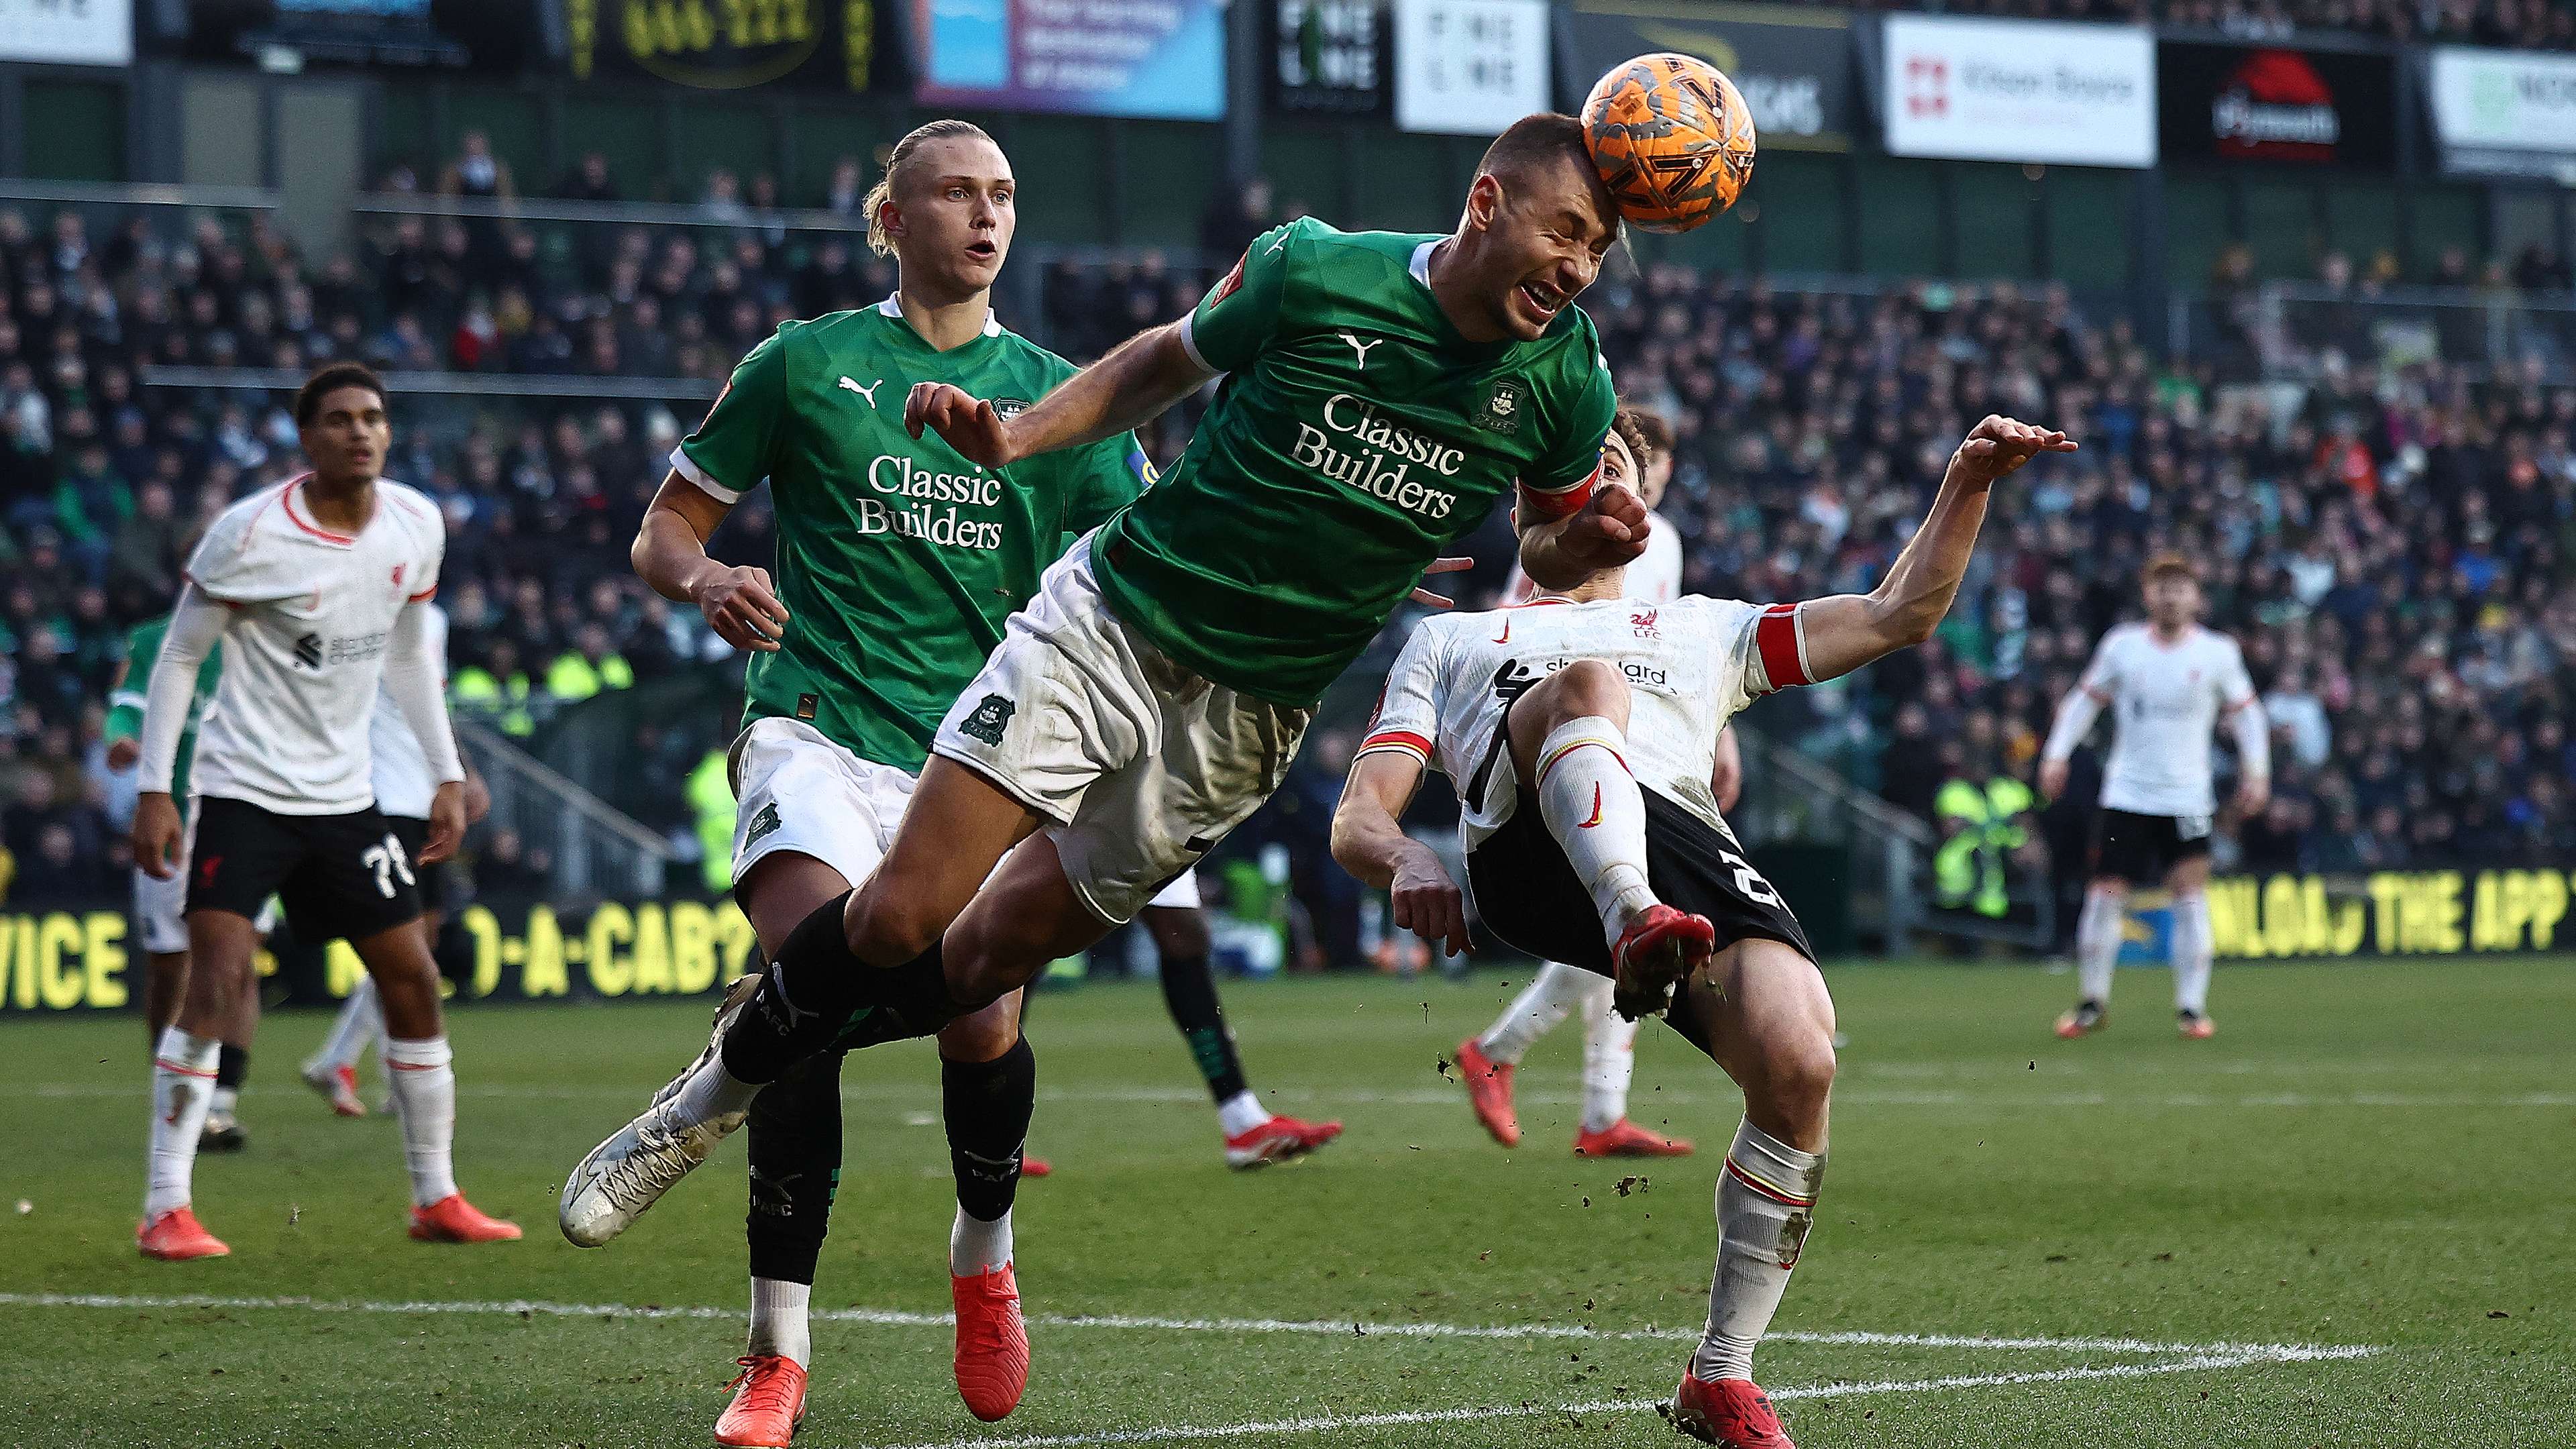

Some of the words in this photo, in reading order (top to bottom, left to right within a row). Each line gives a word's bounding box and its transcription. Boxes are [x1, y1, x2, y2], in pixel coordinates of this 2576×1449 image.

[1323, 393, 1465, 476] Classic
[867, 454, 1002, 507] Classic
[1290, 421, 1457, 521] Builders
[855, 497, 1003, 551] Builders
[1546, 657, 1666, 685] stard
[2369, 870, 2465, 953] THE
[2471, 868, 2569, 951] APP
